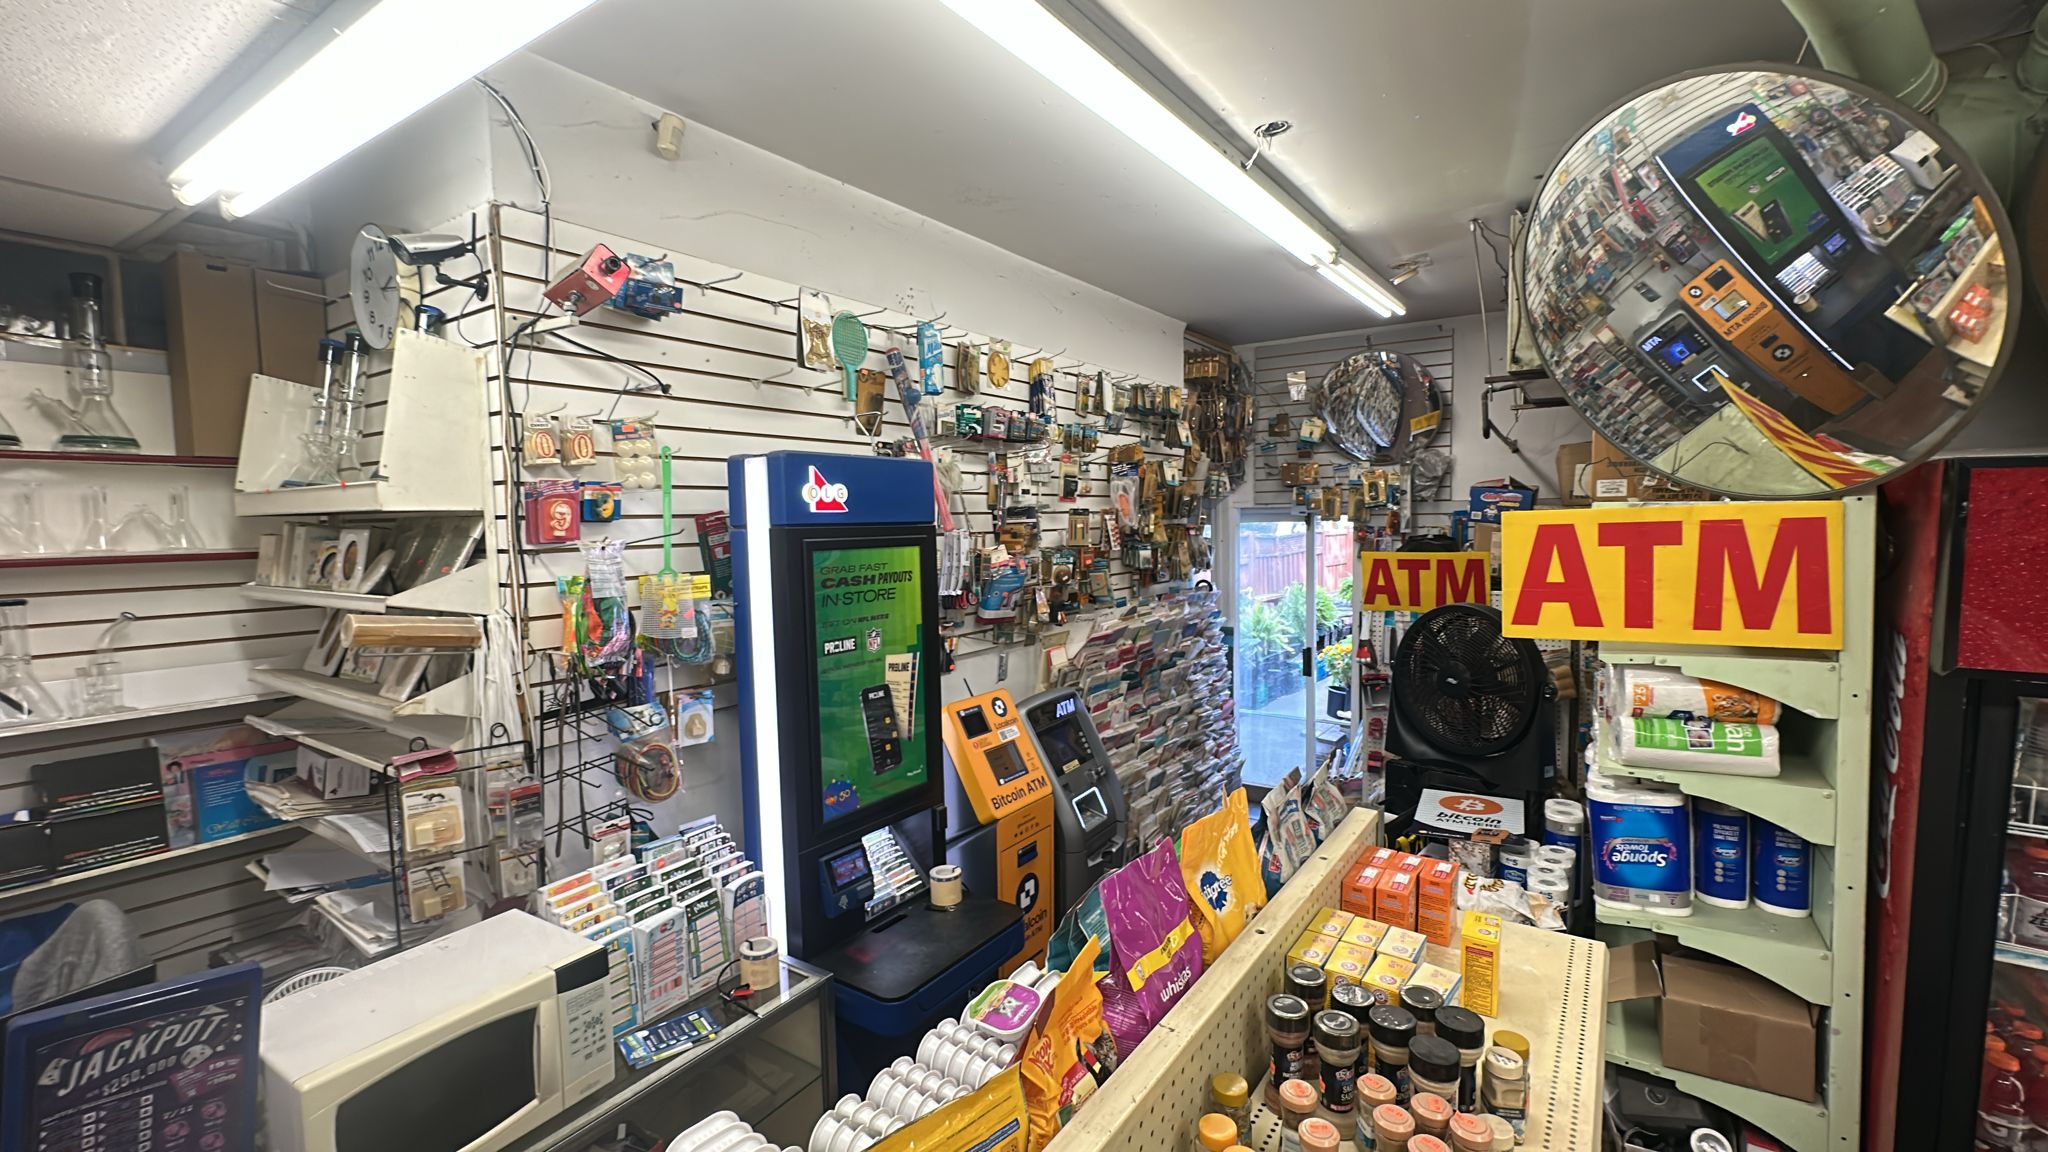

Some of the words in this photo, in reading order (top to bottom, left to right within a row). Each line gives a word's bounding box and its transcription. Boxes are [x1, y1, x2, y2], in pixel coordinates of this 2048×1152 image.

[820, 565, 856, 576] GRAB
[859, 563, 888, 572] FAST
[1511, 516, 1832, 634] ATM
[820, 574, 876, 589] CASH
[878, 570, 913, 584] PAYOUTS
[1363, 558, 1485, 607] ATM
[1056, 698, 1076, 718] ATM
[991, 787, 1027, 810] Bitcoin
[1027, 775, 1048, 794] ATM
[1437, 812, 1502, 824] bitcoin
[1616, 843, 1650, 852] Towels
[1612, 851, 1668, 867] Sponge
[57, 1014, 229, 1097] JACKPOT
